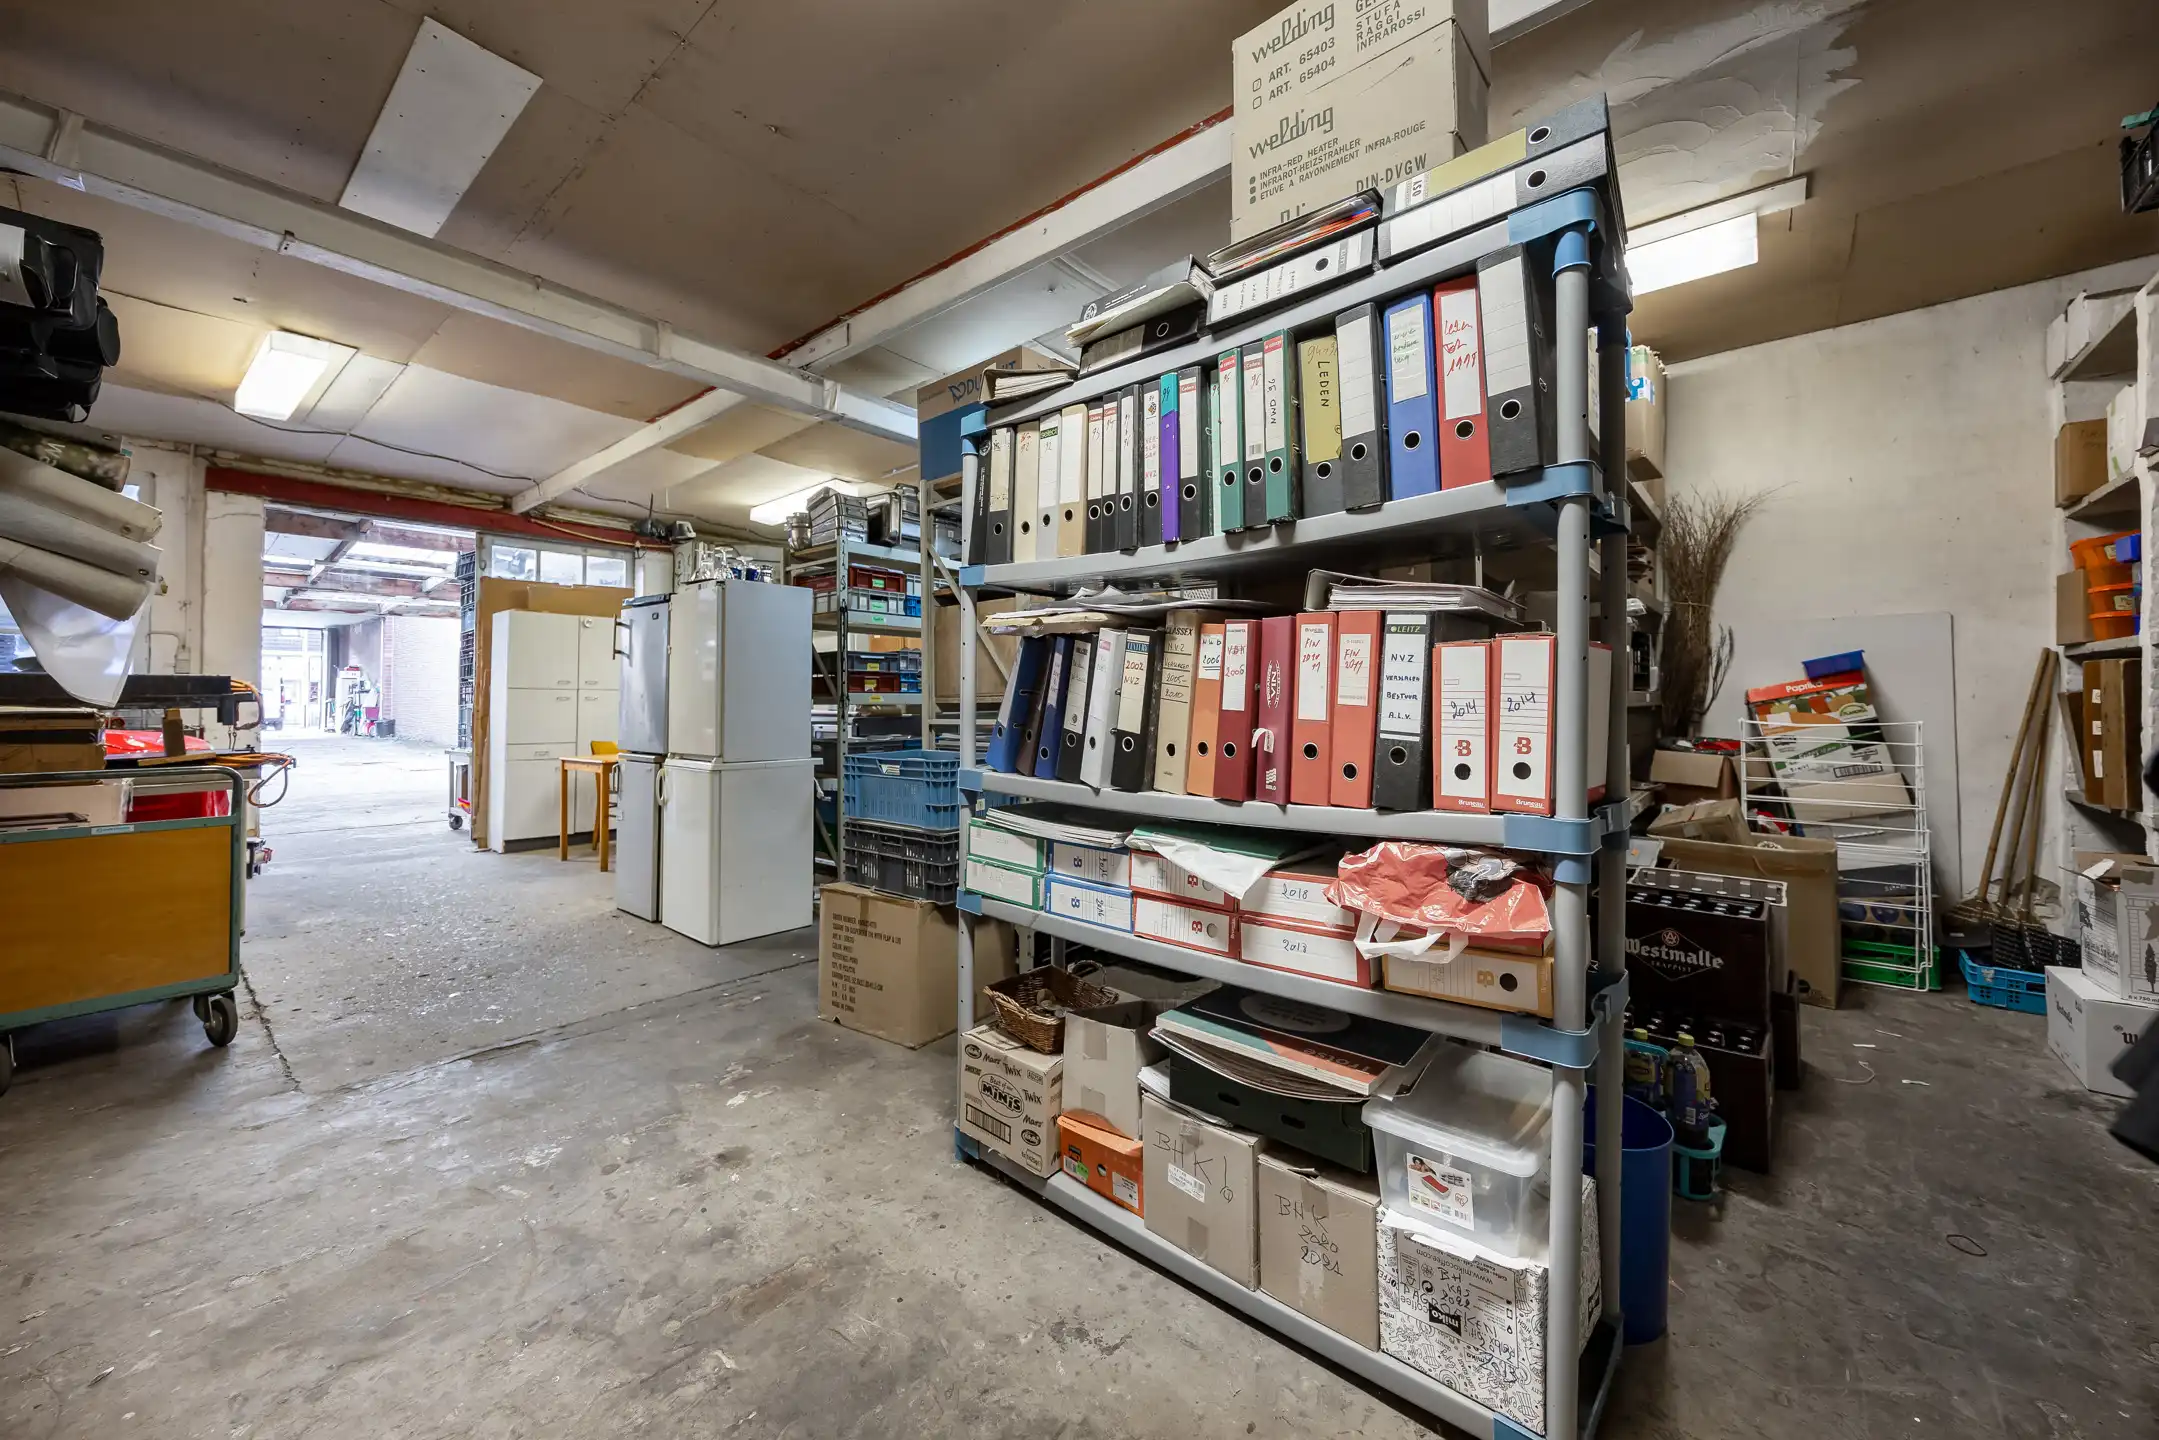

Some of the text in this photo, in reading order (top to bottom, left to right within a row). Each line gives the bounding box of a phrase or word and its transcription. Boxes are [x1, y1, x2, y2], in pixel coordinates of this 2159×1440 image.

[1356, 1, 1401, 31] STUFA
[1357, 10, 1400, 41] RAGGI
[1357, 7, 1426, 52] INFRAROSSI
[1252, 2, 1335, 63] welding
[1268, 37, 1335, 83] ART. 65403
[1268, 56, 1336, 101] ART. 65404
[1249, 106, 1334, 159] welding
[1260, 137, 1339, 181] INFRA-RED HEATER
[1260, 120, 1426, 201] ETUVE A RAYONNEMENT INFRA-ROUGE
[1260, 138, 1361, 190] INFRAROT-HEIZSTRAHLER
[1356, 153, 1427, 193] DIN-DVGW
[1317, 360, 1332, 407] LEDEN
[1397, 625, 1420, 633] LEITZ
[1507, 691, 1536, 712] 2014
[1785, 681, 1823, 692] Paprika
[1451, 699, 1477, 719] 2014
[1458, 799, 1485, 808] Bruneau
[1516, 798, 1544, 808] Bruneau
[1282, 883, 1308, 901] 2018
[1625, 938, 1724, 969] Westmalle
[1021, 1088, 1042, 1104] Twix
[1416, 1248, 1494, 1285] www.mikocoffee.com
[1400, 1295, 1429, 1314] coffee
[1431, 1310, 1460, 1329] miko
